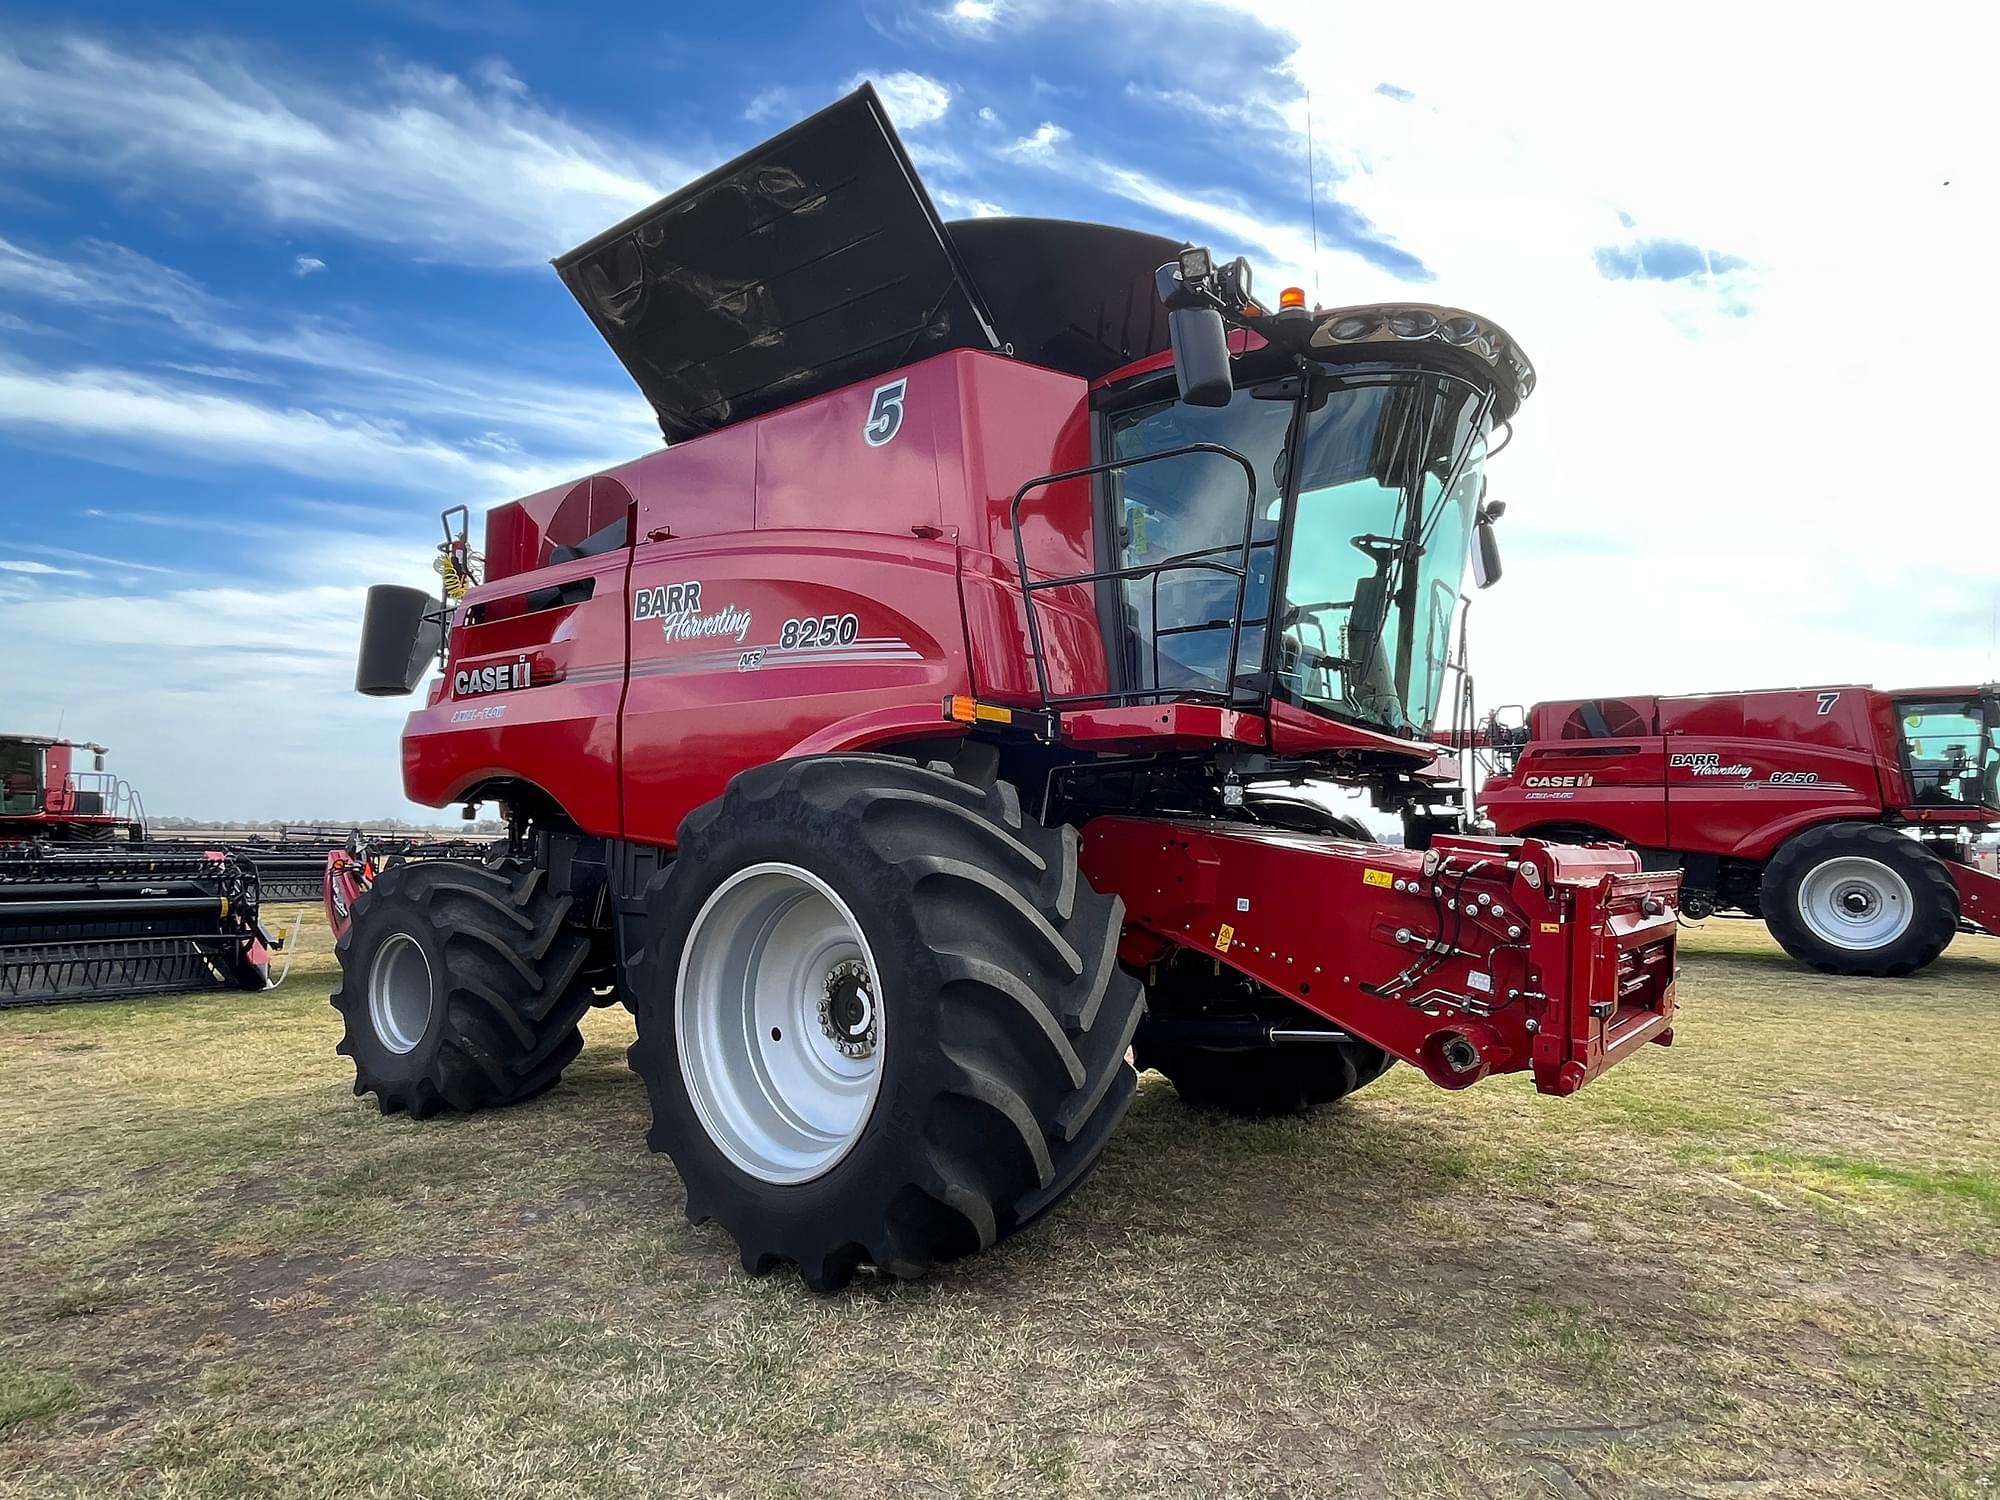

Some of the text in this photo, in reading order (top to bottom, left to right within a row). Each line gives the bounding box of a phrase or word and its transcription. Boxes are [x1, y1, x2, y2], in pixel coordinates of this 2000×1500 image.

[864, 376, 908, 447] 5
[634, 581, 702, 621] BARR
[663, 604, 752, 643] Harvesting
[779, 613, 859, 650] 8250
[455, 665, 510, 695] CASE
[1816, 692, 1841, 715] 7
[1670, 754, 1719, 767] BARR
[1692, 764, 1753, 778] Harvesting
[1525, 776, 1576, 788] CASE
[1769, 772, 1818, 784] 8250
